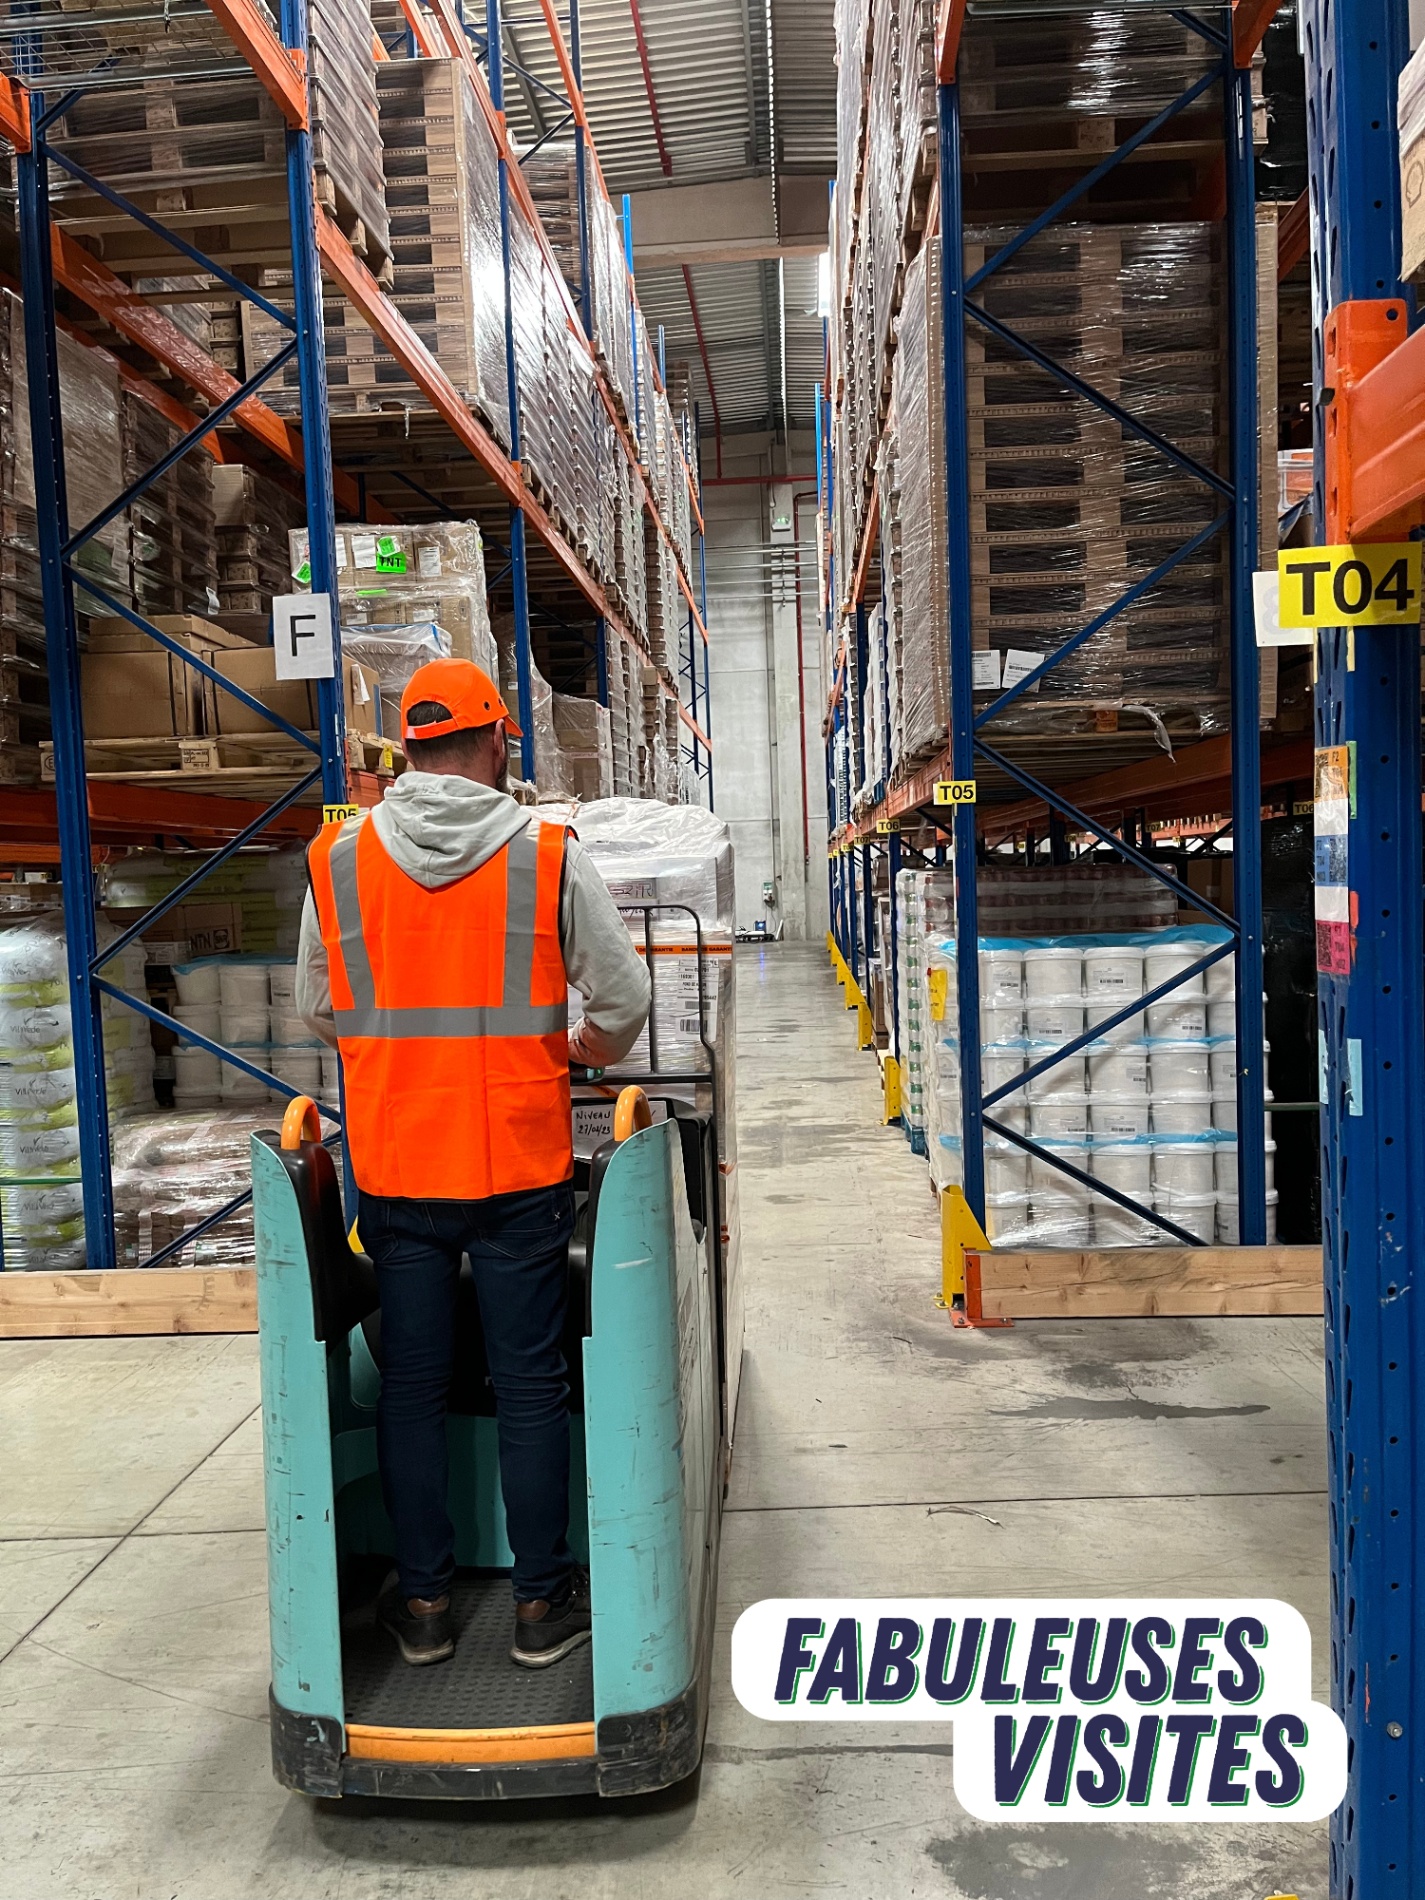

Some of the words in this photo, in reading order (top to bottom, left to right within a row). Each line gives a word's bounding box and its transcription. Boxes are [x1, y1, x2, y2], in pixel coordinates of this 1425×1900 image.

[379, 556, 403, 568] TNT
[1286, 558, 1415, 616] T04
[289, 614, 316, 657] F
[940, 785, 974, 801] T05
[1295, 803, 1314, 814] T06
[879, 821, 899, 831] T06
[190, 933, 212, 950] NTN
